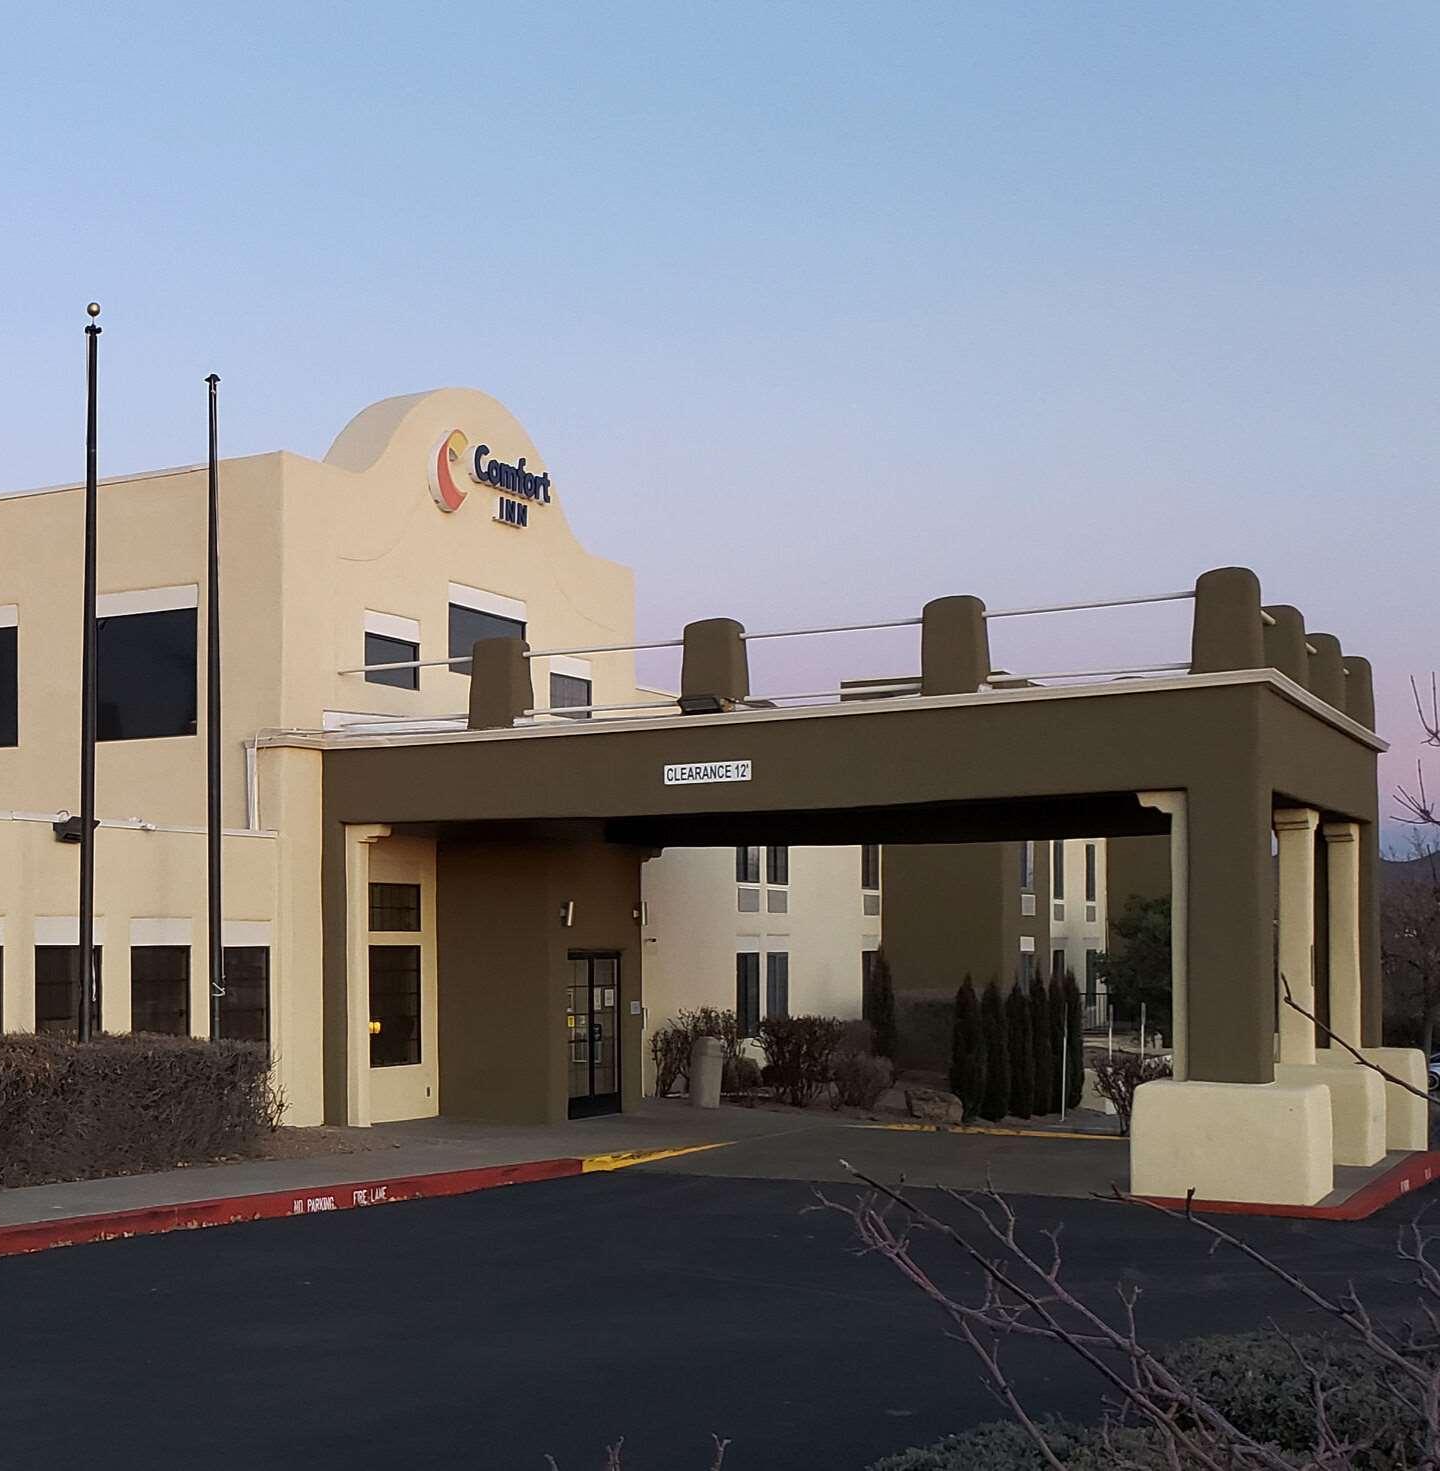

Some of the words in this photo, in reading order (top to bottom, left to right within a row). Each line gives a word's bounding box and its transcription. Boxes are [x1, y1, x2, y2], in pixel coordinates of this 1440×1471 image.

[473, 444, 551, 504] Comfort
[498, 496, 528, 527] INN
[666, 765, 731, 781] CLEARANCE
[293, 1199, 304, 1213] NO
[371, 1187, 387, 1202] LANE
